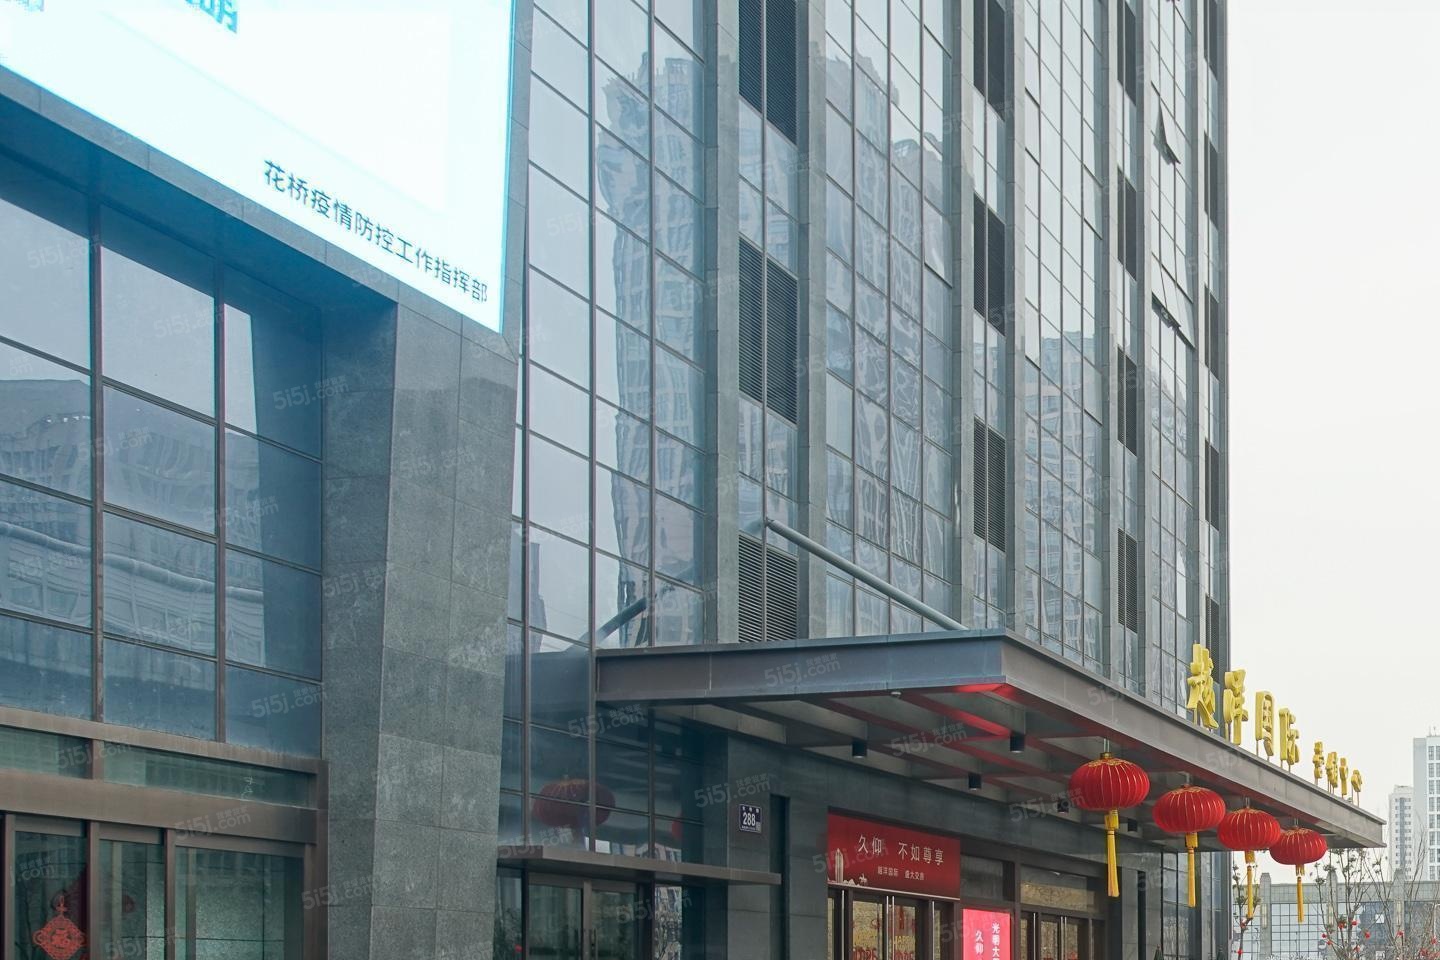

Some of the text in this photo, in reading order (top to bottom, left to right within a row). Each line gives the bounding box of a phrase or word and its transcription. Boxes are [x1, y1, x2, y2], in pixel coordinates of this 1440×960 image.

[264, 159, 487, 303] 花桥疫情防控工作指挥部
[742, 812, 756, 827] 288
[857, 835, 944, 866] 久仰 不如尊享
